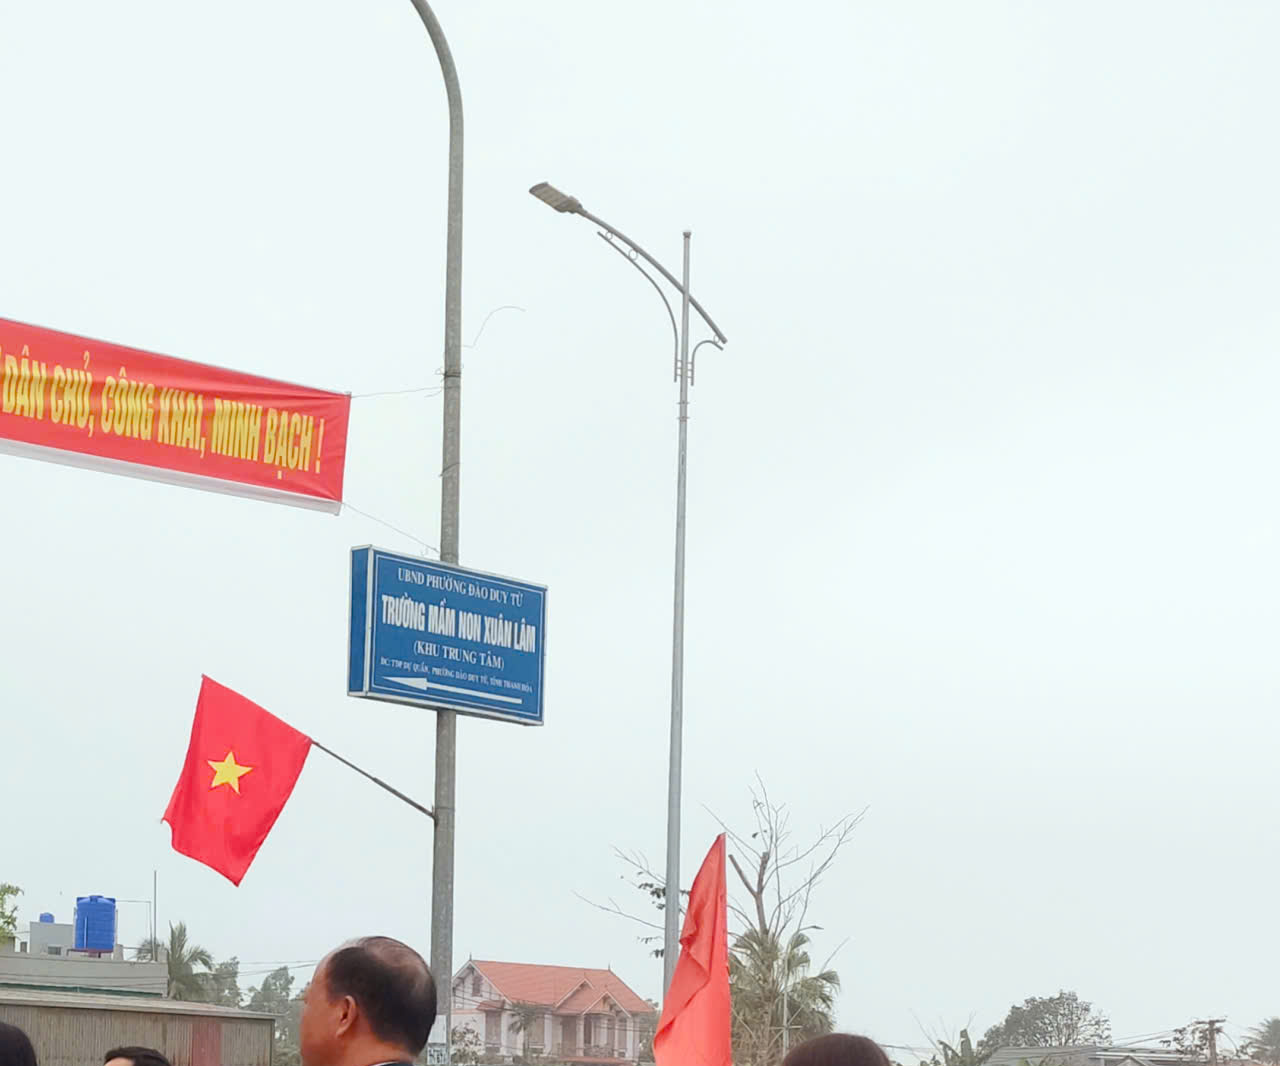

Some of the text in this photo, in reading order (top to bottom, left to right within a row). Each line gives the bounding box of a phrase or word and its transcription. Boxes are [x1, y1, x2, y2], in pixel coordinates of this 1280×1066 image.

[2, 345, 47, 420] DÂN
[50, 350, 95, 438] CHỦ,
[101, 366, 156, 441] CÔNG
[157, 387, 206, 459] KHAI,
[211, 398, 263, 462] MINH
[263, 407, 314, 480] BẠCH
[398, 567, 425, 585] UBND
[426, 574, 467, 595] PHƯỜNG
[468, 581, 489, 600] ĐÀO
[490, 588, 509, 604] DUY
[381, 592, 536, 653] TRƯỜNG MẦM NON XUÂN LÂM
[413, 640, 505, 671] (KHU TRUNG TÂM)
